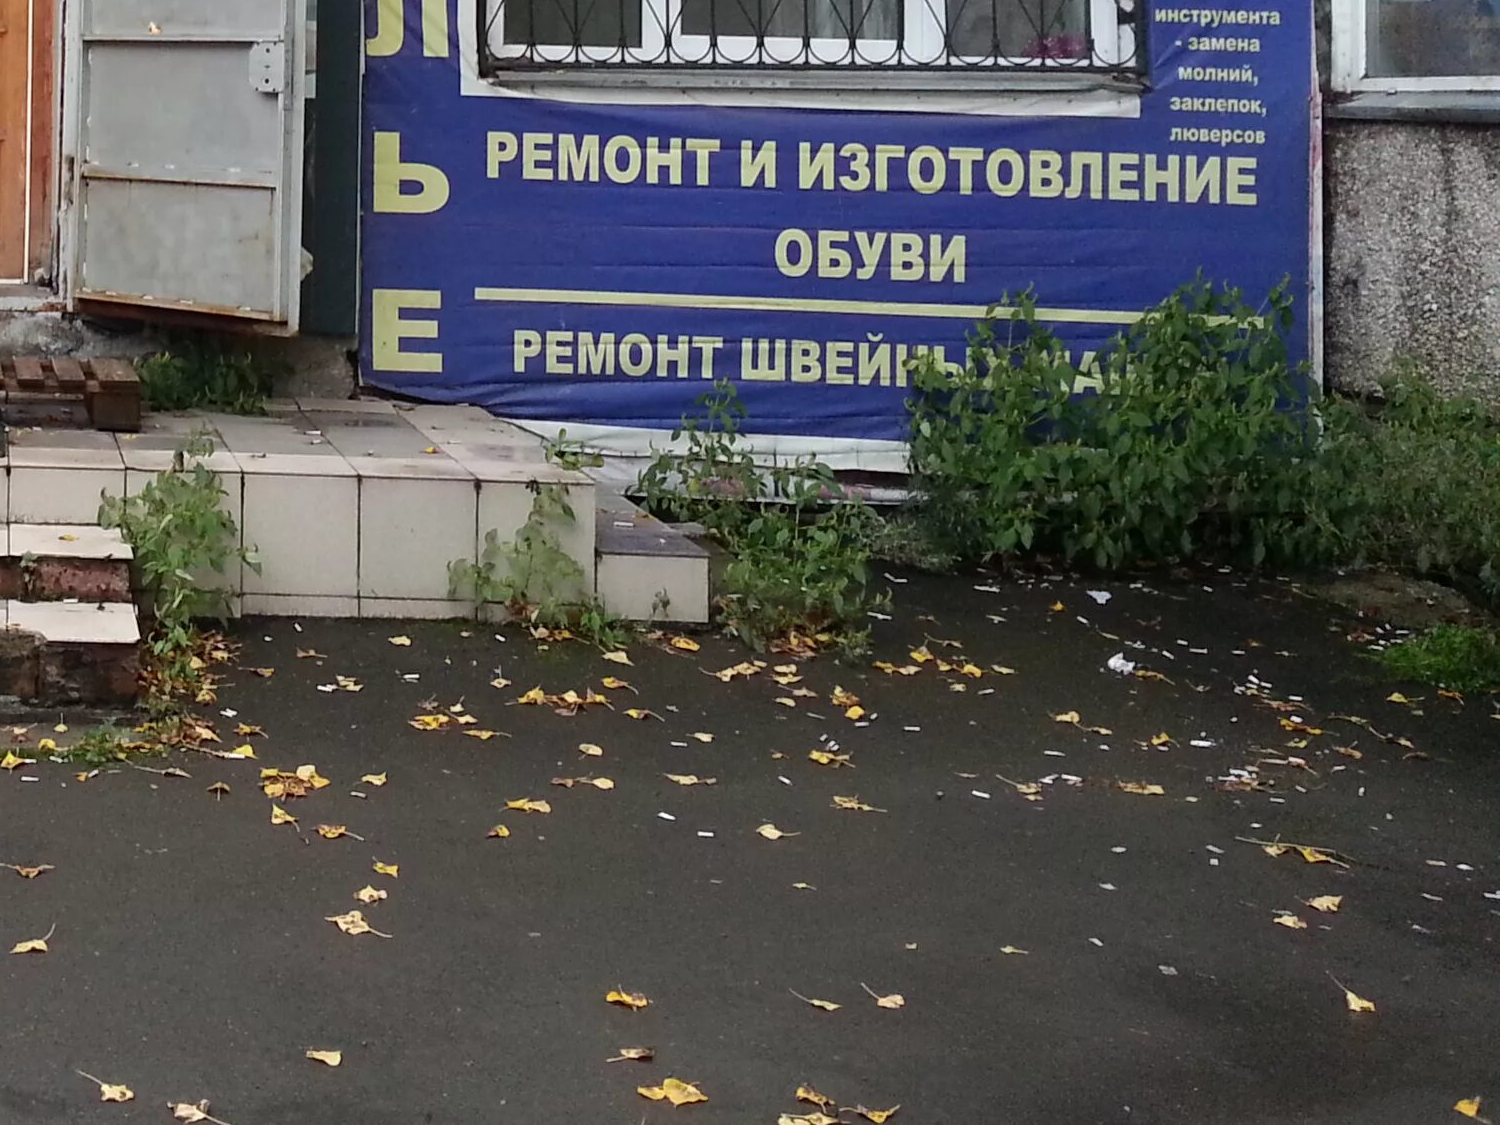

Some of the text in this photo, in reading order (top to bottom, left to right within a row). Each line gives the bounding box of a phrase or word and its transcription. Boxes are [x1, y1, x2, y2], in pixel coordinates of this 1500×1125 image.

[1155, 8, 1281, 27] инструмента
[1188, 36, 1261, 52] замена
[1178, 64, 1258, 86] молний,
[1170, 96, 1267, 117] заклепок,
[1170, 127, 1265, 147] люверсов
[486, 130, 1261, 206] РЕМОНТ И ИЗГОТОВЛЕНИЕ
[774, 228, 966, 283] ОБУВИ
[513, 329, 723, 382] РЕМОНТ
